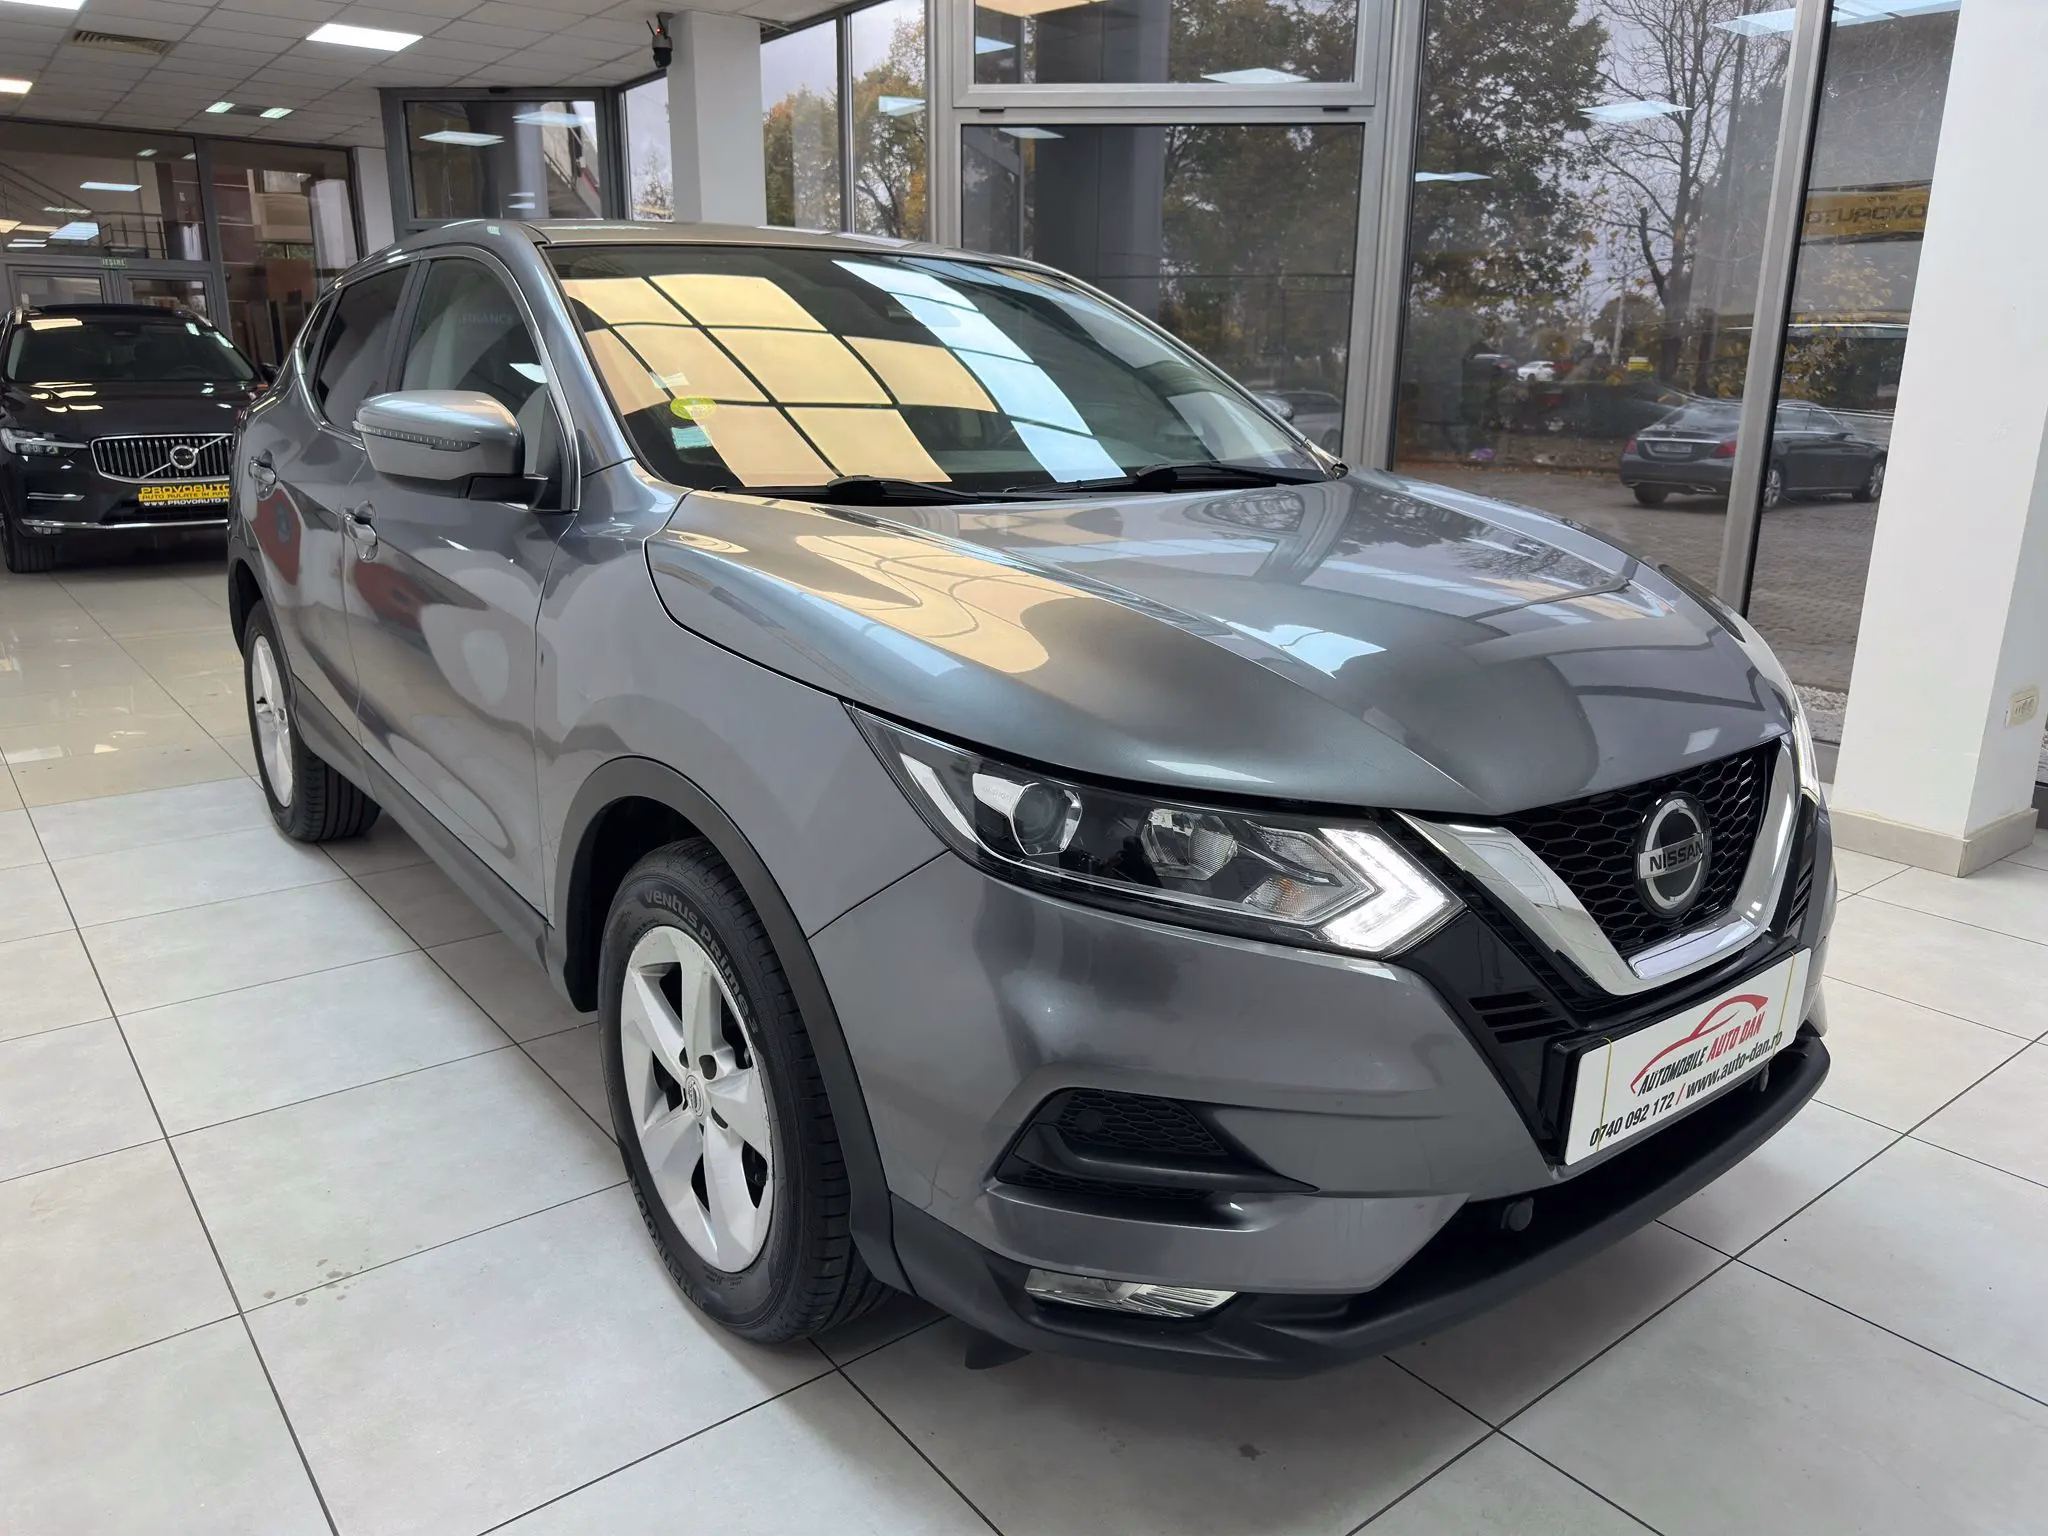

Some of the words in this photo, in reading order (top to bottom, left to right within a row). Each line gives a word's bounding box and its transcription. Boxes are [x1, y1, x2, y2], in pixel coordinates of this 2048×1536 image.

[1649, 841, 1703, 872] NISSAN
[1589, 1116, 1624, 1147] 0740
[1624, 1104, 1650, 1130] 092
[1652, 1091, 1676, 1116] 172
[1685, 1030, 1783, 1099] www.auto-dan.ro
[1637, 1045, 1709, 1097] AUTOMOBILE
[1706, 1025, 1741, 1063] AUTO
[1738, 1011, 1766, 1045] DAN
